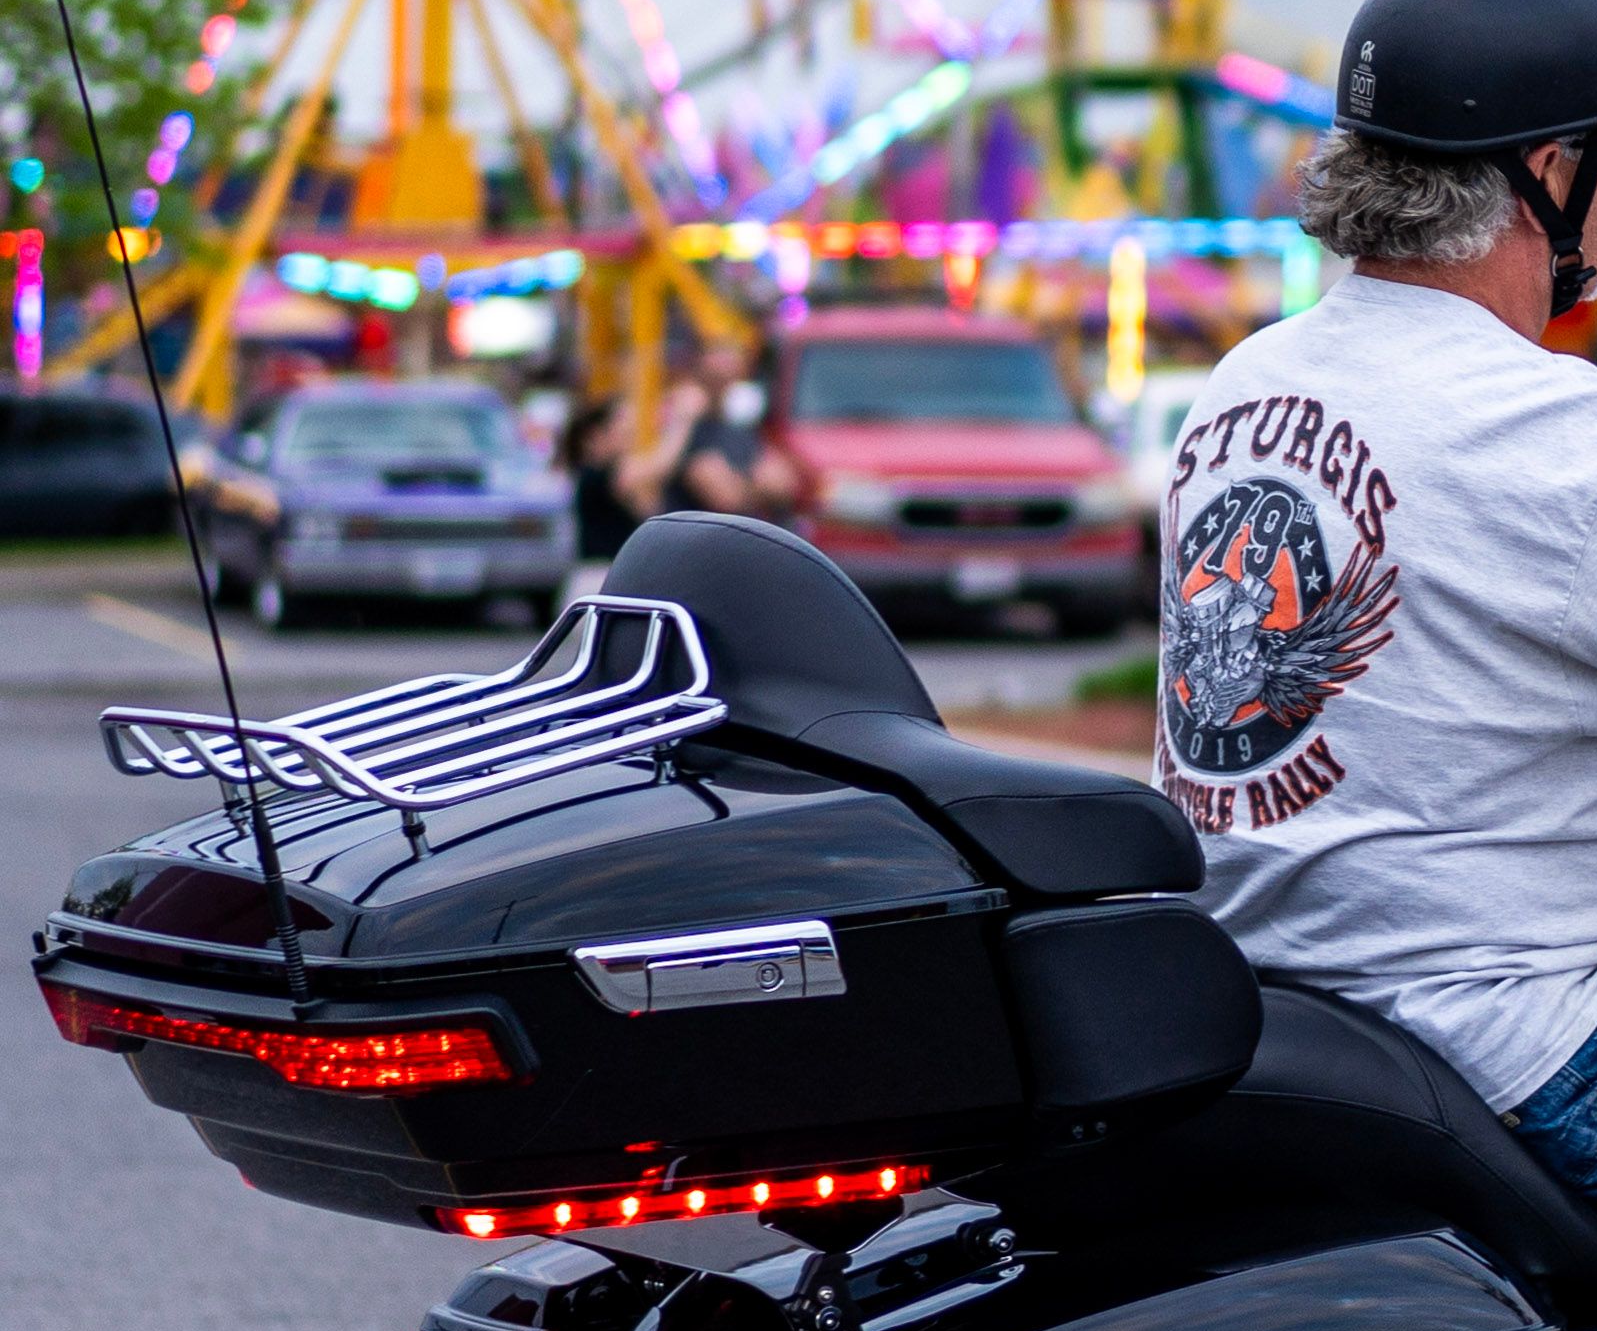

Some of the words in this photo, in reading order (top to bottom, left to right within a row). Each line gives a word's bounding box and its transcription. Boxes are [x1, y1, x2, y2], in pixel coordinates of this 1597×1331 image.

[1351, 74, 1373, 96] DOT
[1172, 395, 1397, 558] STURGIS
[1173, 716, 1253, 766] 2019
[1246, 734, 1346, 831] RALLY
